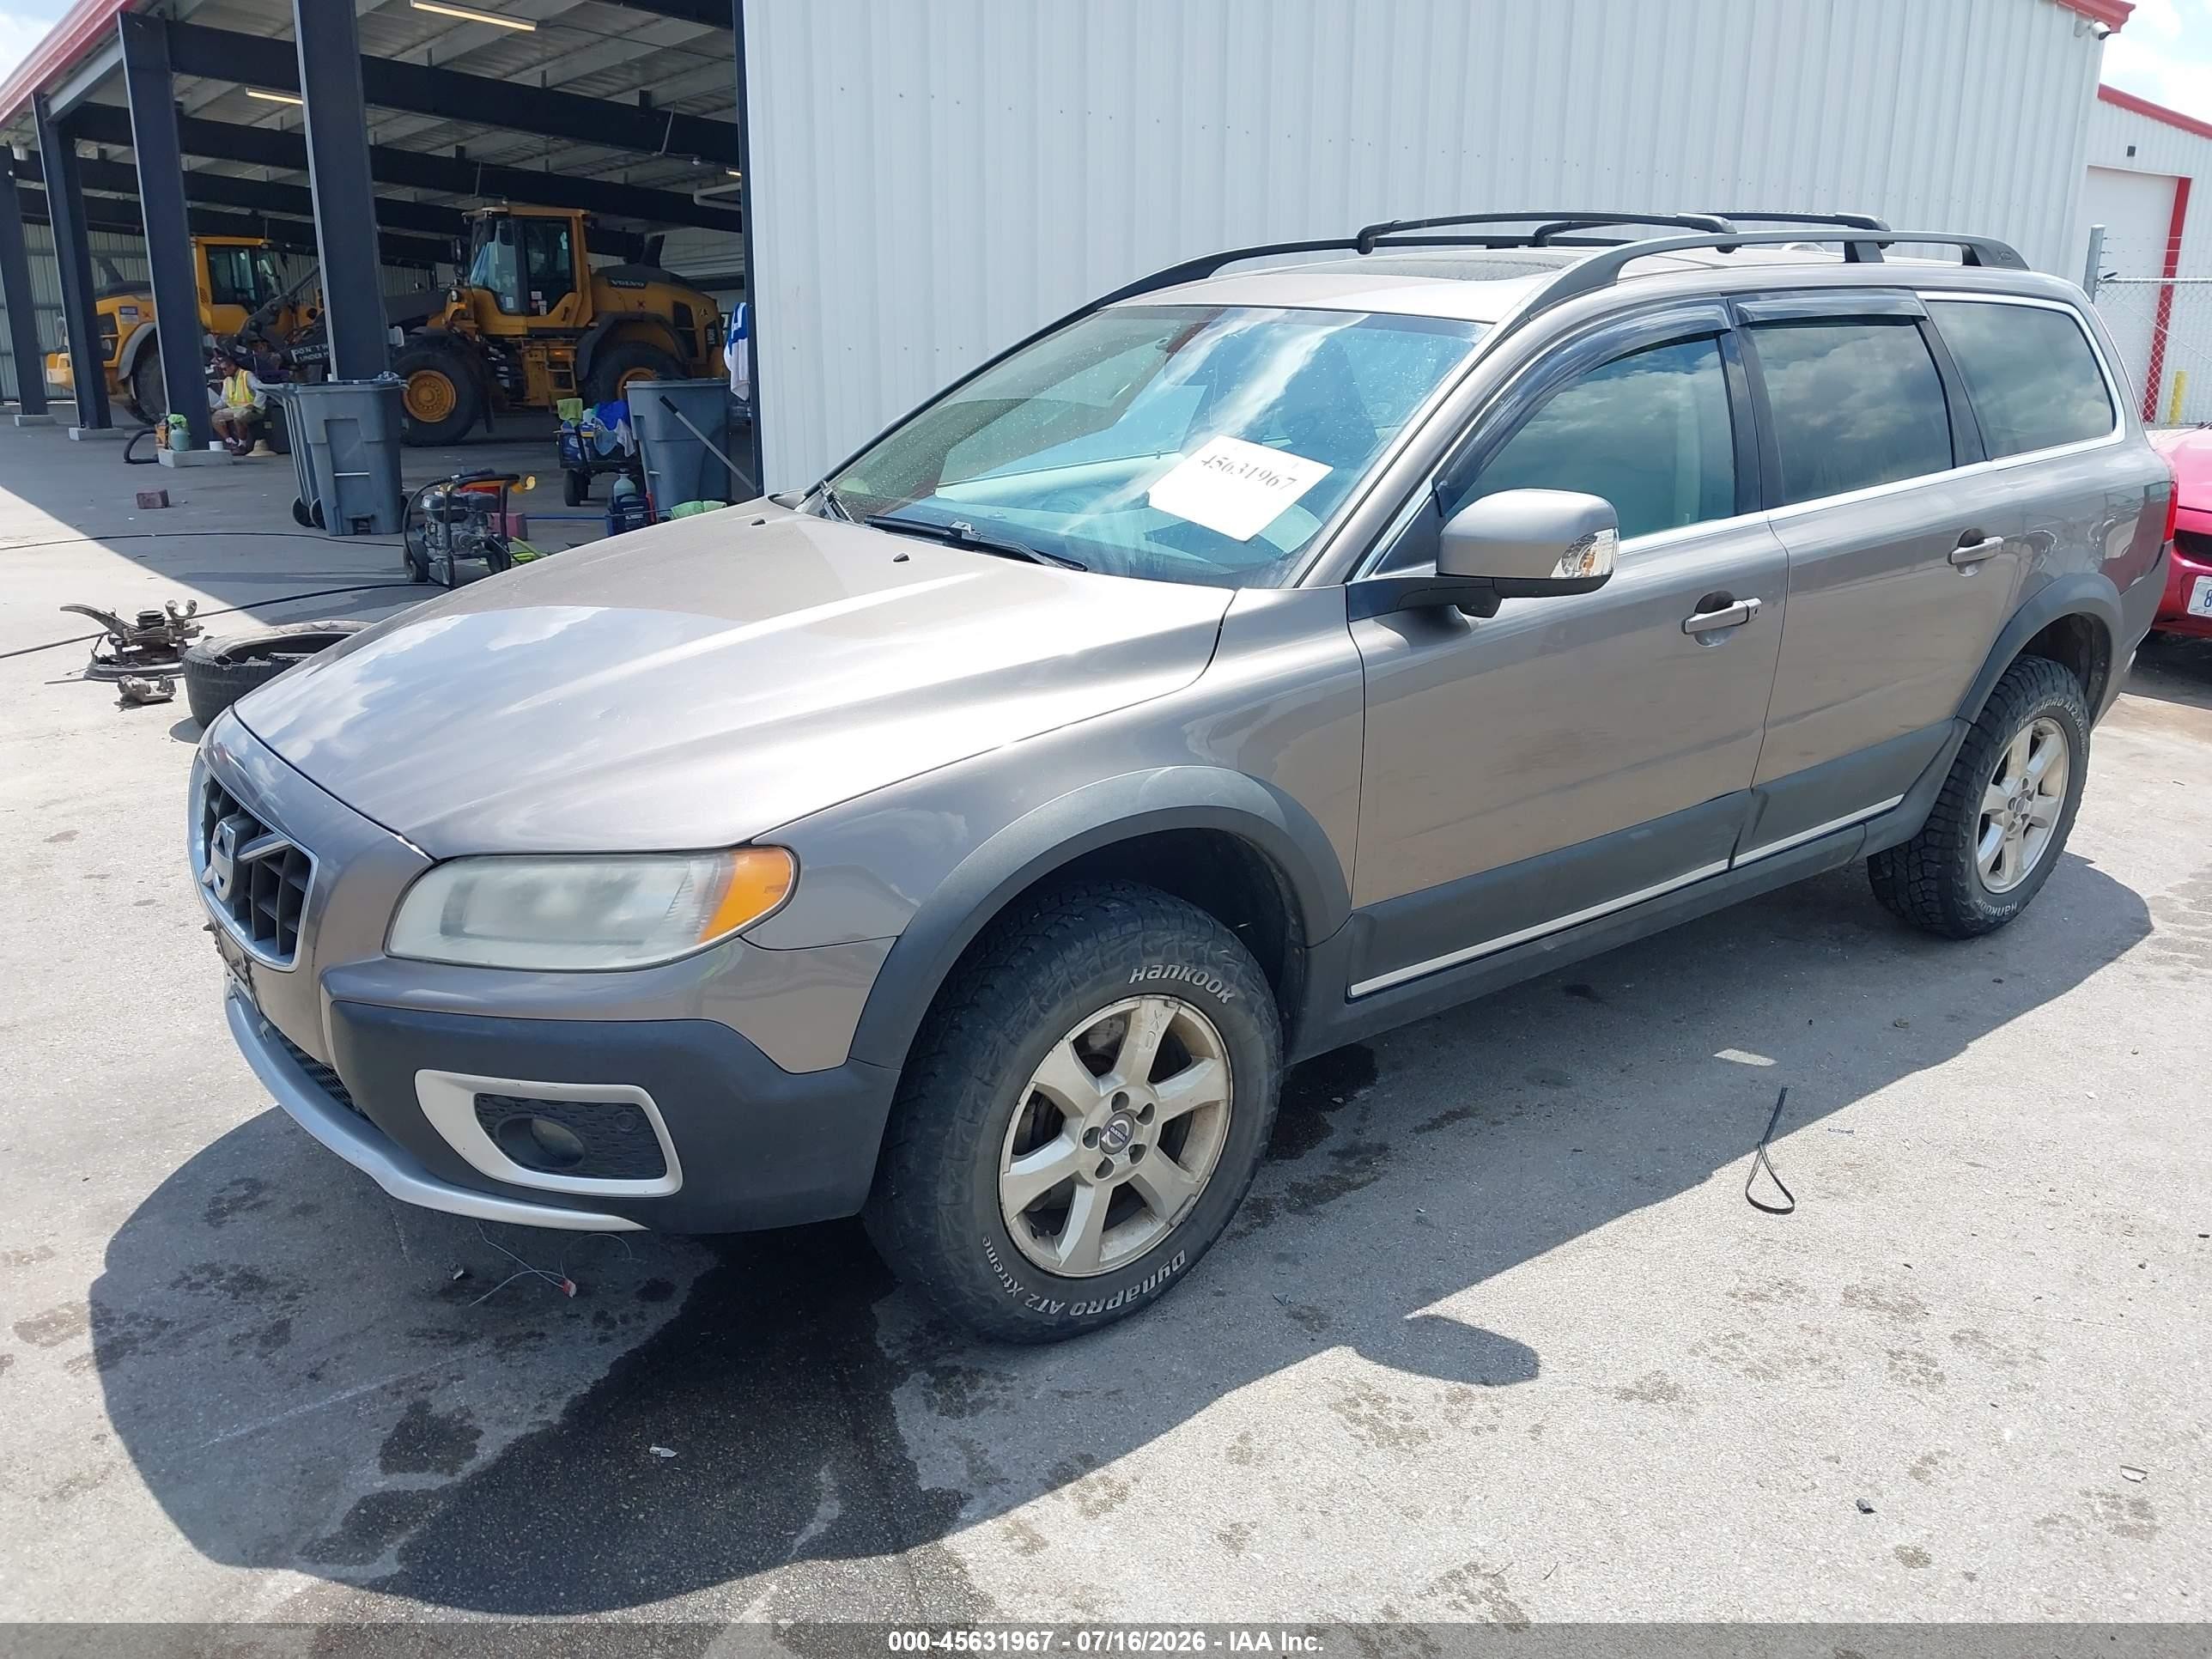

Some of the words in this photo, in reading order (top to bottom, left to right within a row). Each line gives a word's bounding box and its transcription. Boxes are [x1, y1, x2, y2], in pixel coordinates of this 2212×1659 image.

[1201, 455, 1297, 489] 45631967
[2063, 701, 2078, 717] AT2
[1109, 1126, 1127, 1142] VOLVO
[982, 1236, 1024, 1298] Xtreme
[1024, 1292, 1066, 1315] AT2
